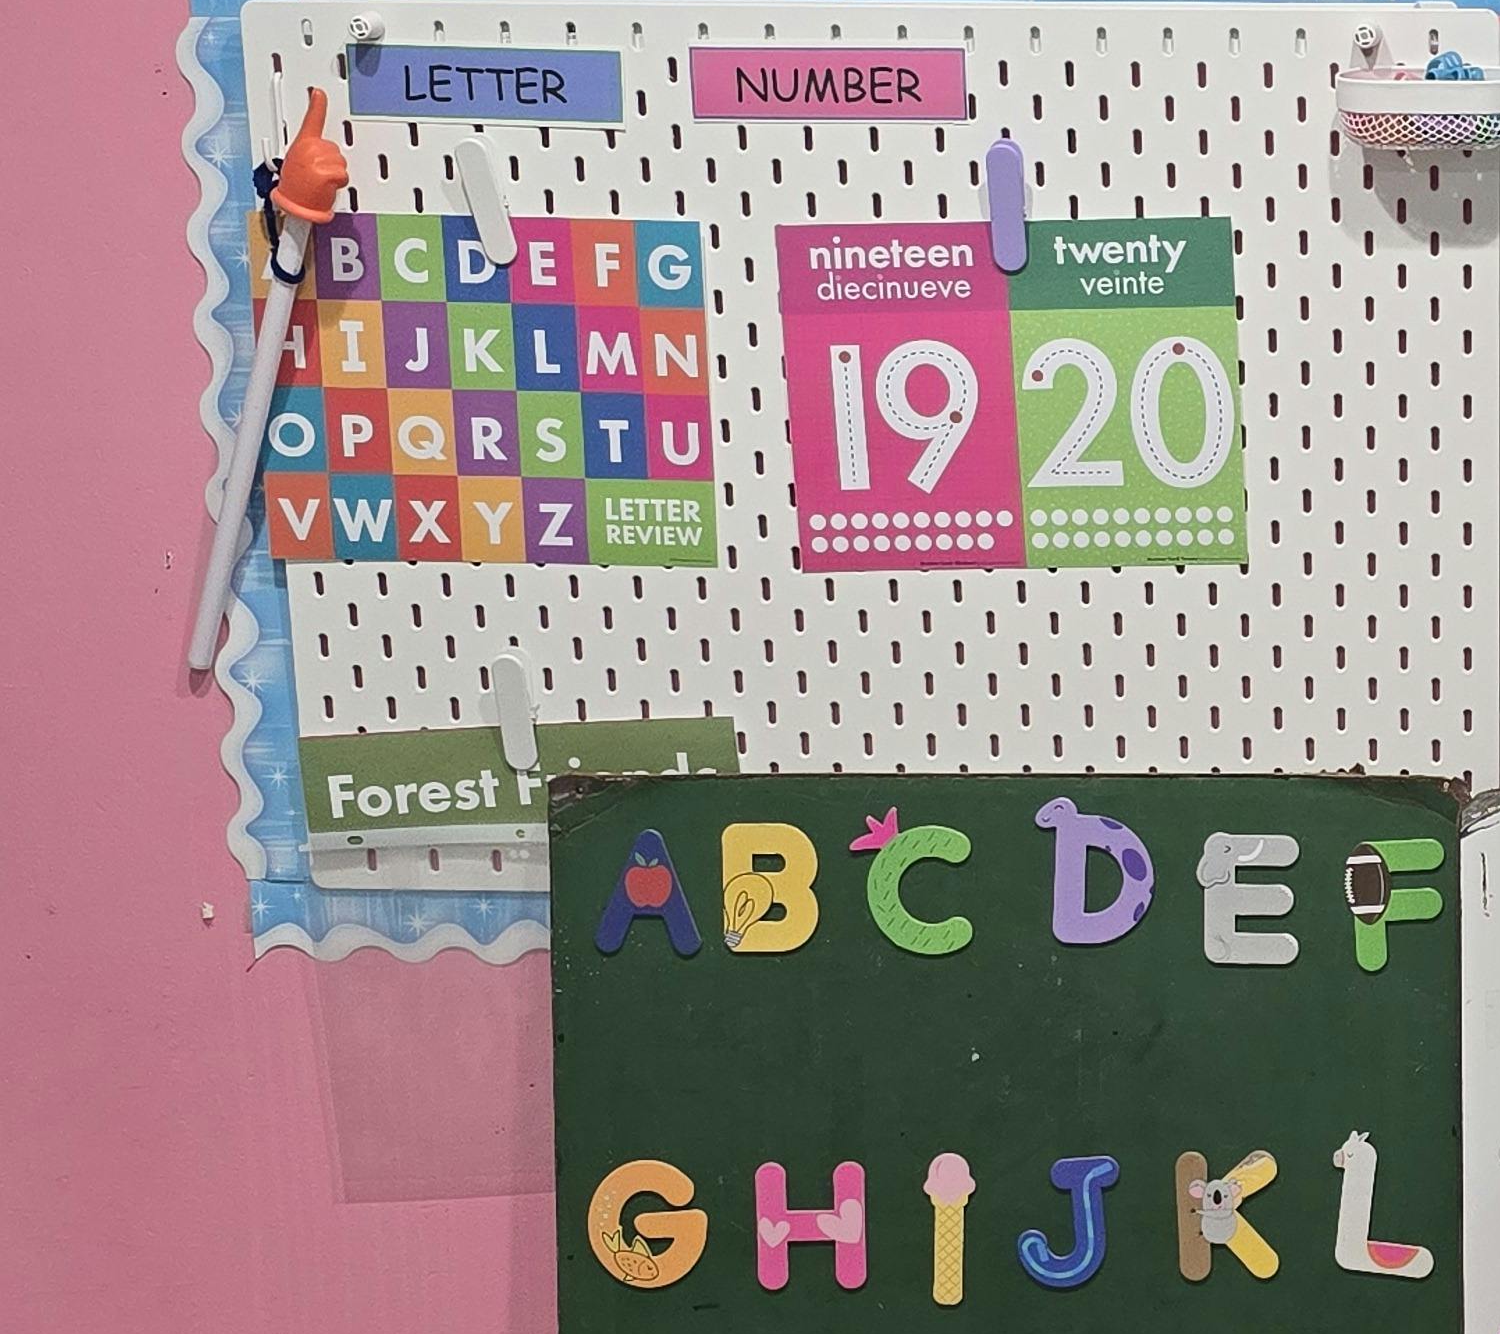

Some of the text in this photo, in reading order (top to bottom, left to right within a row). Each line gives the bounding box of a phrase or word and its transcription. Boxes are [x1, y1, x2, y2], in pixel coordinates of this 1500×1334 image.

[403, 64, 569, 106] LETTER
[735, 66, 923, 104] NUMBER
[330, 236, 366, 282] B
[393, 238, 430, 284] C
[457, 238, 497, 281] D
[527, 240, 558, 287] E
[594, 242, 621, 289] F
[647, 245, 693, 291] G
[809, 236, 975, 271] nineteen
[1053, 233, 1188, 274] twenty
[816, 274, 972, 303] diecinueve
[1080, 269, 1166, 296] veinte
[338, 319, 367, 373] I
[404, 327, 429, 373] J
[462, 327, 505, 374] K
[533, 329, 561, 375] L
[584, 330, 639, 378] M
[654, 332, 699, 379] N
[828, 338, 980, 496] 19
[1021, 335, 1236, 490] 20
[269, 411, 701, 467] O P Q R S T U
[276, 497, 576, 548] V W X Y Z
[604, 496, 702, 524] LETTER
[605, 524, 704, 548] REVIEW
[326, 768, 500, 819] Forest
[596, 795, 1446, 973] A B C D E F
[587, 1130, 1435, 1306] G H I J K L
